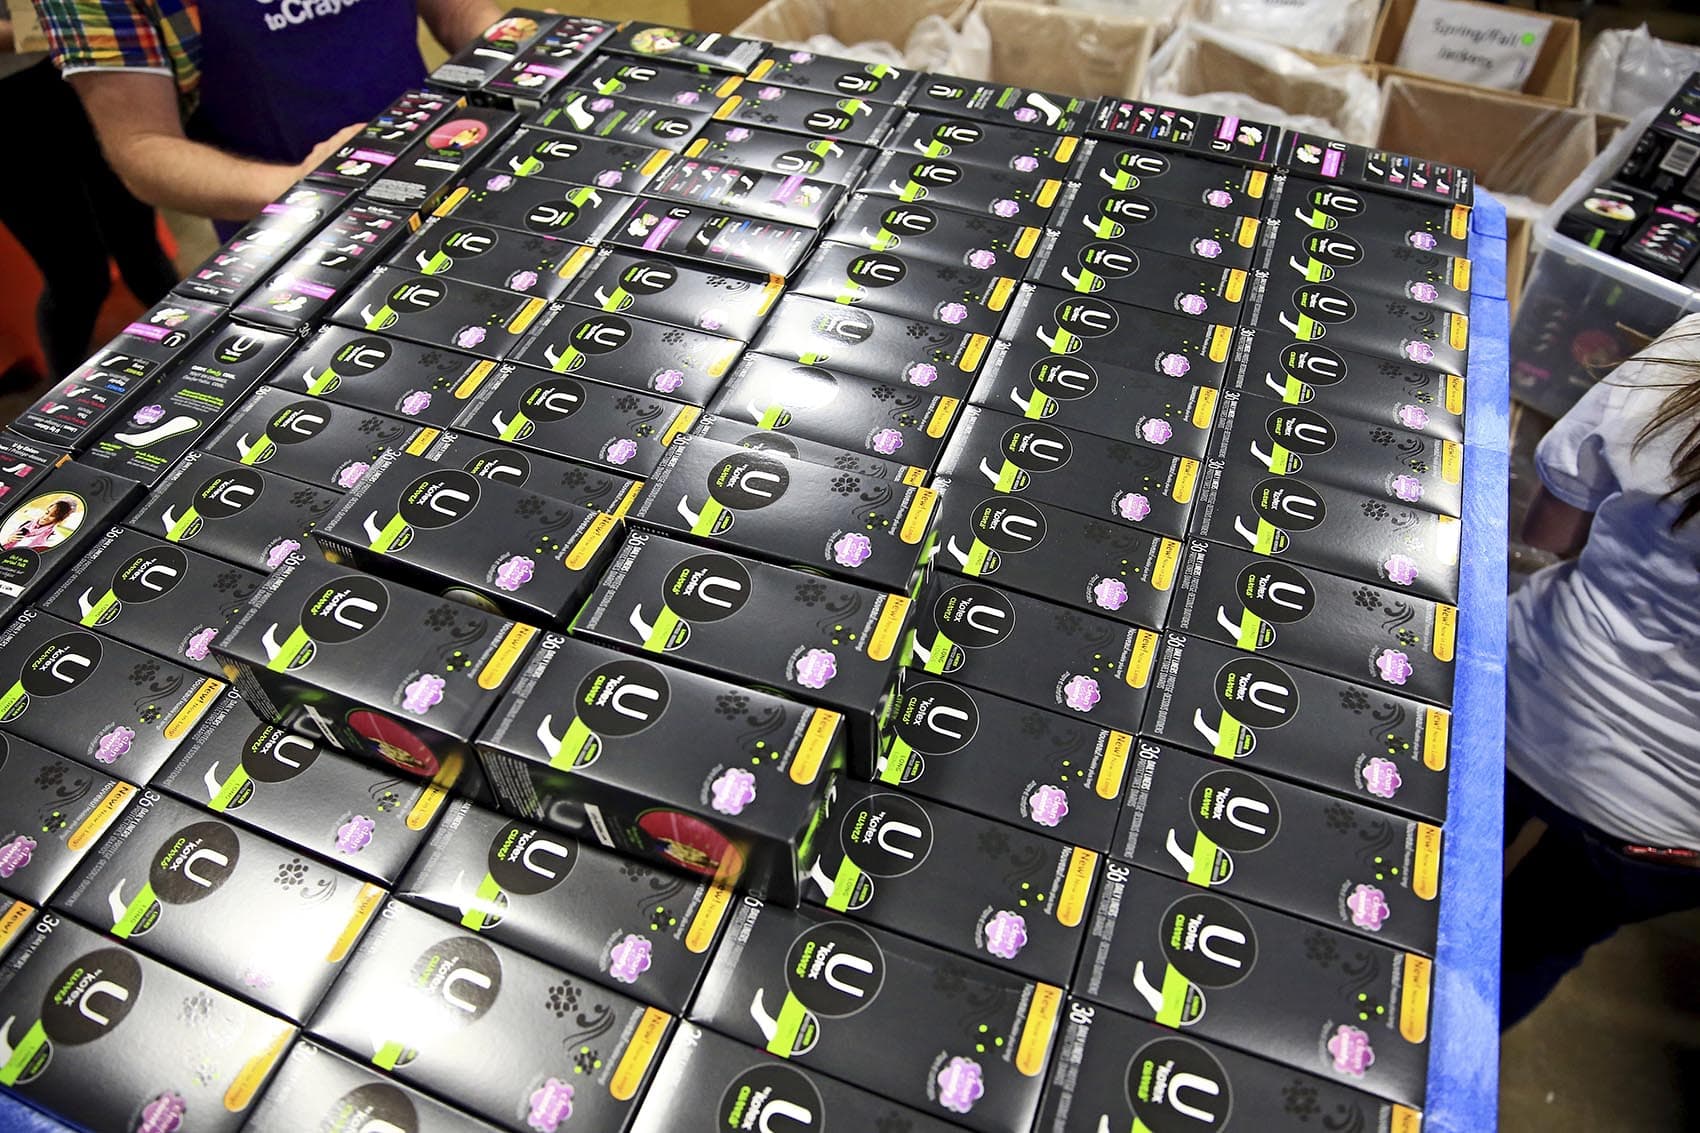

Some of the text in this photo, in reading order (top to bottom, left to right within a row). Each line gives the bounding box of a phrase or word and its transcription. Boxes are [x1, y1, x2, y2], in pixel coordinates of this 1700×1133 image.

[264, 0, 361, 31] to Cray
[839, 76, 863, 88] U
[808, 114, 834, 126] U
[952, 129, 978, 141] U
[551, 144, 577, 157] U
[776, 156, 804, 170] U
[1137, 158, 1163, 171] U
[930, 168, 956, 182] U
[1122, 204, 1149, 218] U
[1331, 197, 1357, 211] U
[531, 207, 558, 222] U
[903, 215, 930, 230] U
[462, 237, 490, 252] U
[1328, 243, 1355, 259] U
[1103, 254, 1131, 271] U
[642, 272, 671, 288] U
[871, 265, 900, 280] U
[410, 289, 439, 306] U
[1319, 298, 1347, 315] U
[1081, 311, 1110, 328] U
[594, 328, 625, 346] U
[354, 350, 385, 368] U
[1308, 358, 1337, 376] U
[1058, 371, 1089, 390] U
[545, 393, 577, 413] U
[291, 415, 323, 434] U
[1295, 424, 1327, 444] U
[1030, 439, 1063, 461] U
[741, 471, 780, 497] U
[221, 485, 254, 507] U
[430, 490, 469, 516] U
[1282, 496, 1316, 519] U
[107, 527, 124, 539] 36
[1002, 516, 1037, 540] U
[629, 533, 649, 546] 36
[1191, 540, 1208, 552] 36
[285, 552, 306, 565] 36
[141, 566, 176, 591] U
[698, 577, 741, 607] U
[1269, 582, 1305, 610] U
[18, 610, 37, 622] 36
[335, 598, 377, 629] U
[967, 606, 1005, 634] U
[543, 634, 565, 650] 36
[1168, 633, 1186, 648] 36
[52, 654, 90, 683] U
[199, 682, 218, 704] New!
[612, 685, 659, 720] U
[1249, 682, 1288, 713] U
[928, 707, 968, 738] U
[274, 736, 313, 767] U
[1139, 743, 1160, 760] 36
[107, 786, 128, 810] New!
[138, 791, 160, 807] 36
[1227, 798, 1269, 834] U
[878, 822, 921, 858] U
[185, 849, 228, 887] U
[524, 840, 567, 878] U
[1106, 863, 1129, 882] 36
[37, 914, 60, 933] 36
[1199, 926, 1245, 967] U
[825, 954, 873, 996] U
[80, 981, 128, 1025] U
[1070, 1003, 1095, 1024] 36
[1168, 1074, 1218, 1122] U
[759, 1101, 811, 1133] U
